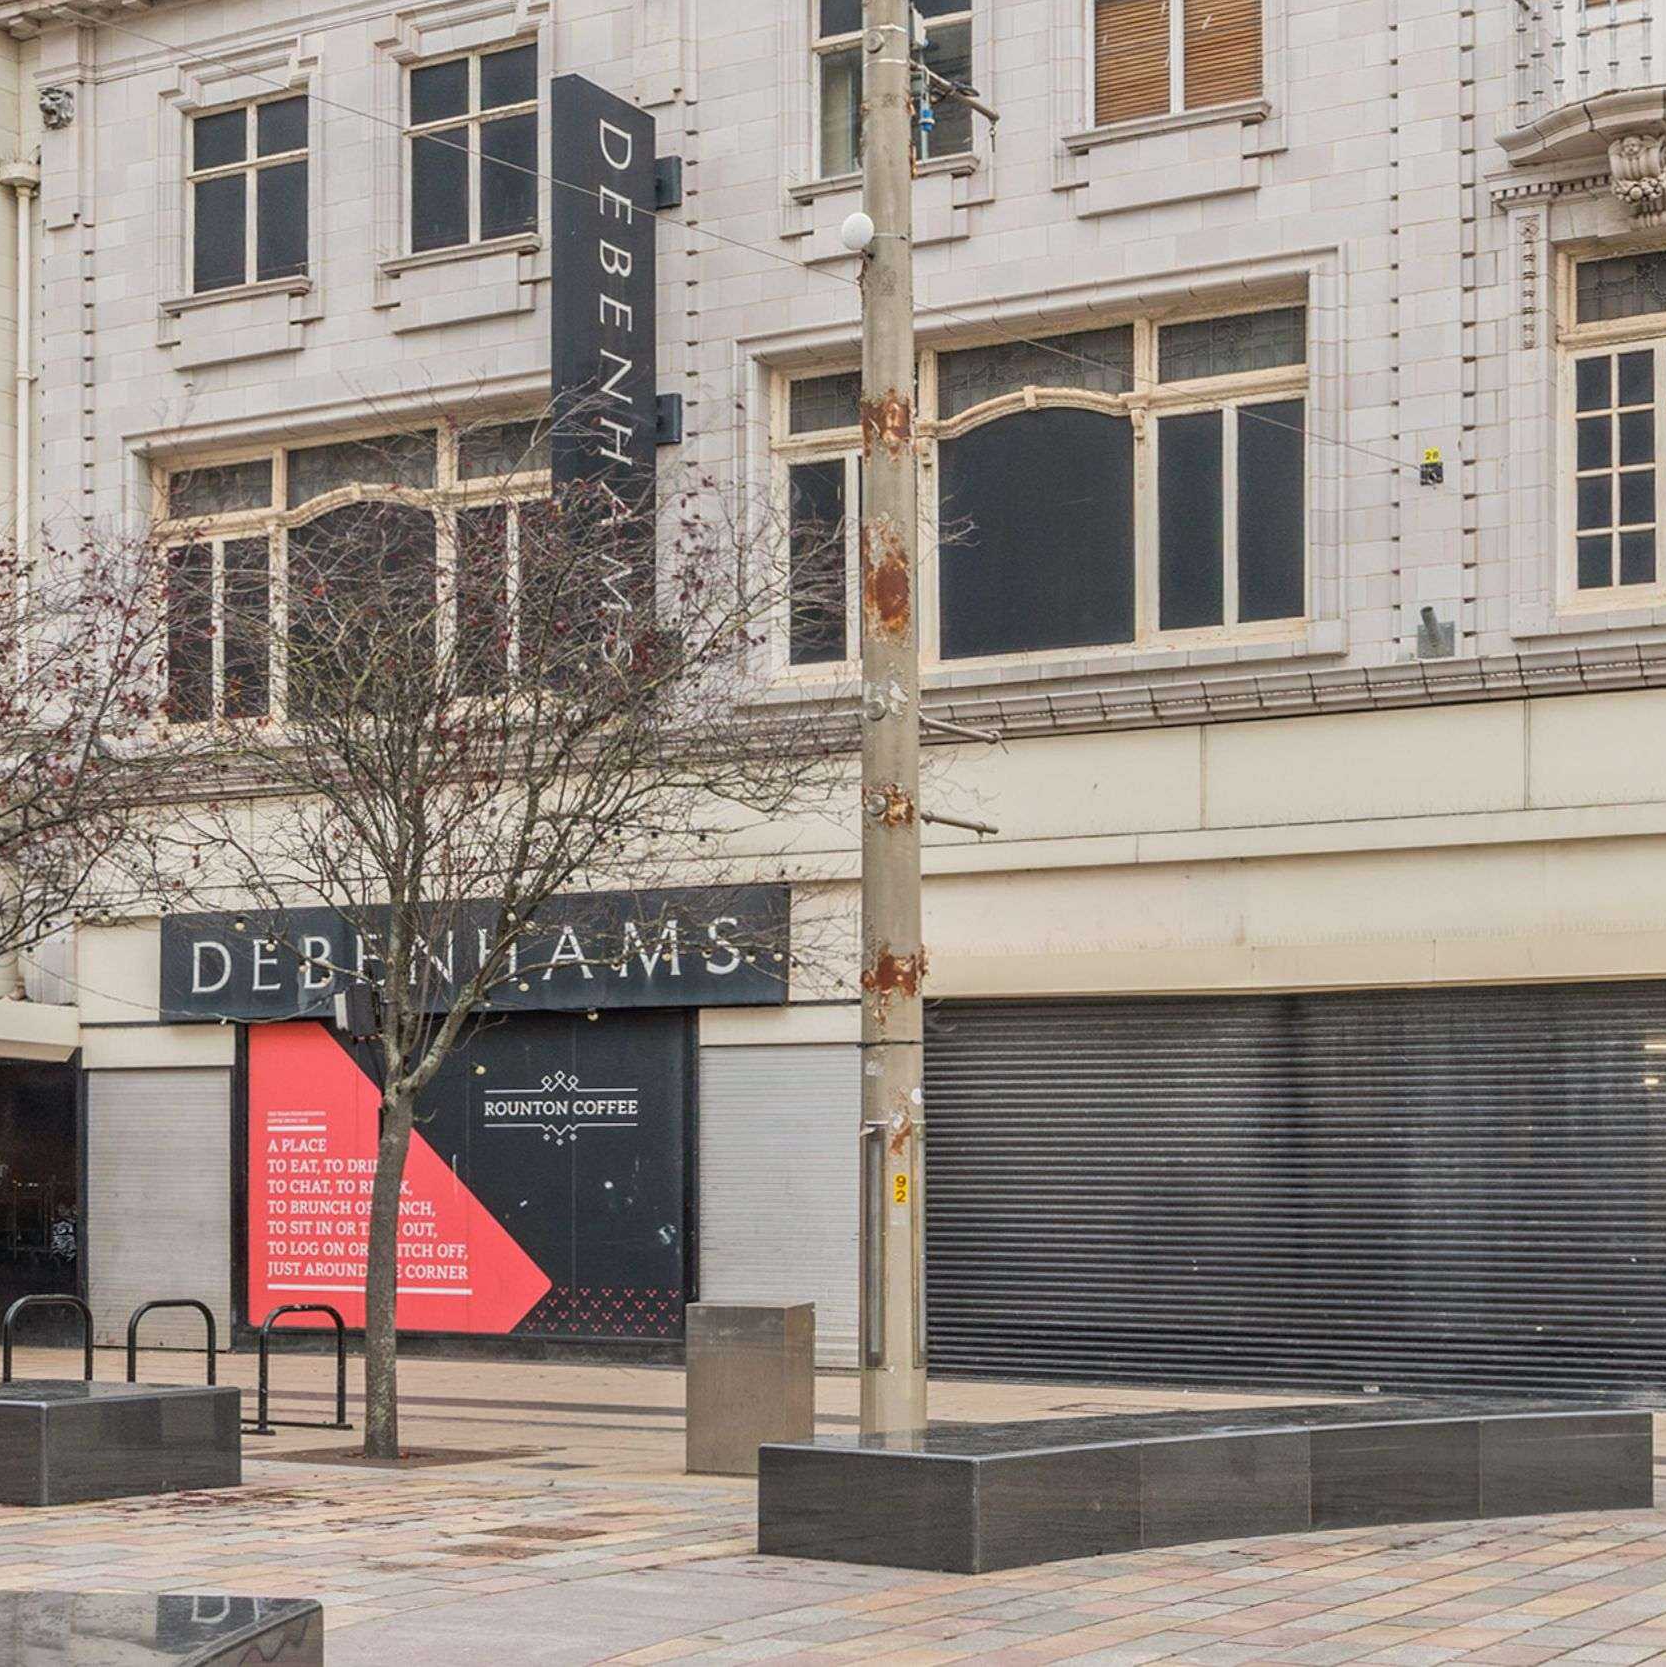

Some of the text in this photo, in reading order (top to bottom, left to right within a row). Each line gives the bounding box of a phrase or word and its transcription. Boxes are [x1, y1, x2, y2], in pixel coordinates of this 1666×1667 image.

[598, 117, 634, 666] DEBENHAMS
[190, 916, 743, 995] DEBENHAMS
[483, 1099, 639, 1116] ROUNTON COFFEE
[267, 1138, 327, 1153] A PLACE
[267, 1159, 287, 1173] TO
[290, 1159, 321, 1175] EAT,
[323, 1159, 344, 1173] TO
[267, 1180, 287, 1194] TO
[290, 1180, 333, 1196] CHAT,
[335, 1180, 356, 1194] TO
[896, 1175, 906, 1203] 92
[267, 1200, 287, 1215] TO
[290, 1201, 352, 1215] BRUNCH
[267, 1221, 287, 1235] TO
[290, 1221, 313, 1235] SIT
[316, 1221, 333, 1235] IN
[336, 1222, 357, 1236] OR
[402, 1223, 439, 1239] OUT,
[267, 1241, 469, 1260] TO LOG ON OR ITCH OFF,
[267, 1261, 301, 1278] JUST
[304, 1262, 369, 1277] AROUND
[405, 1265, 469, 1280] CORNER
